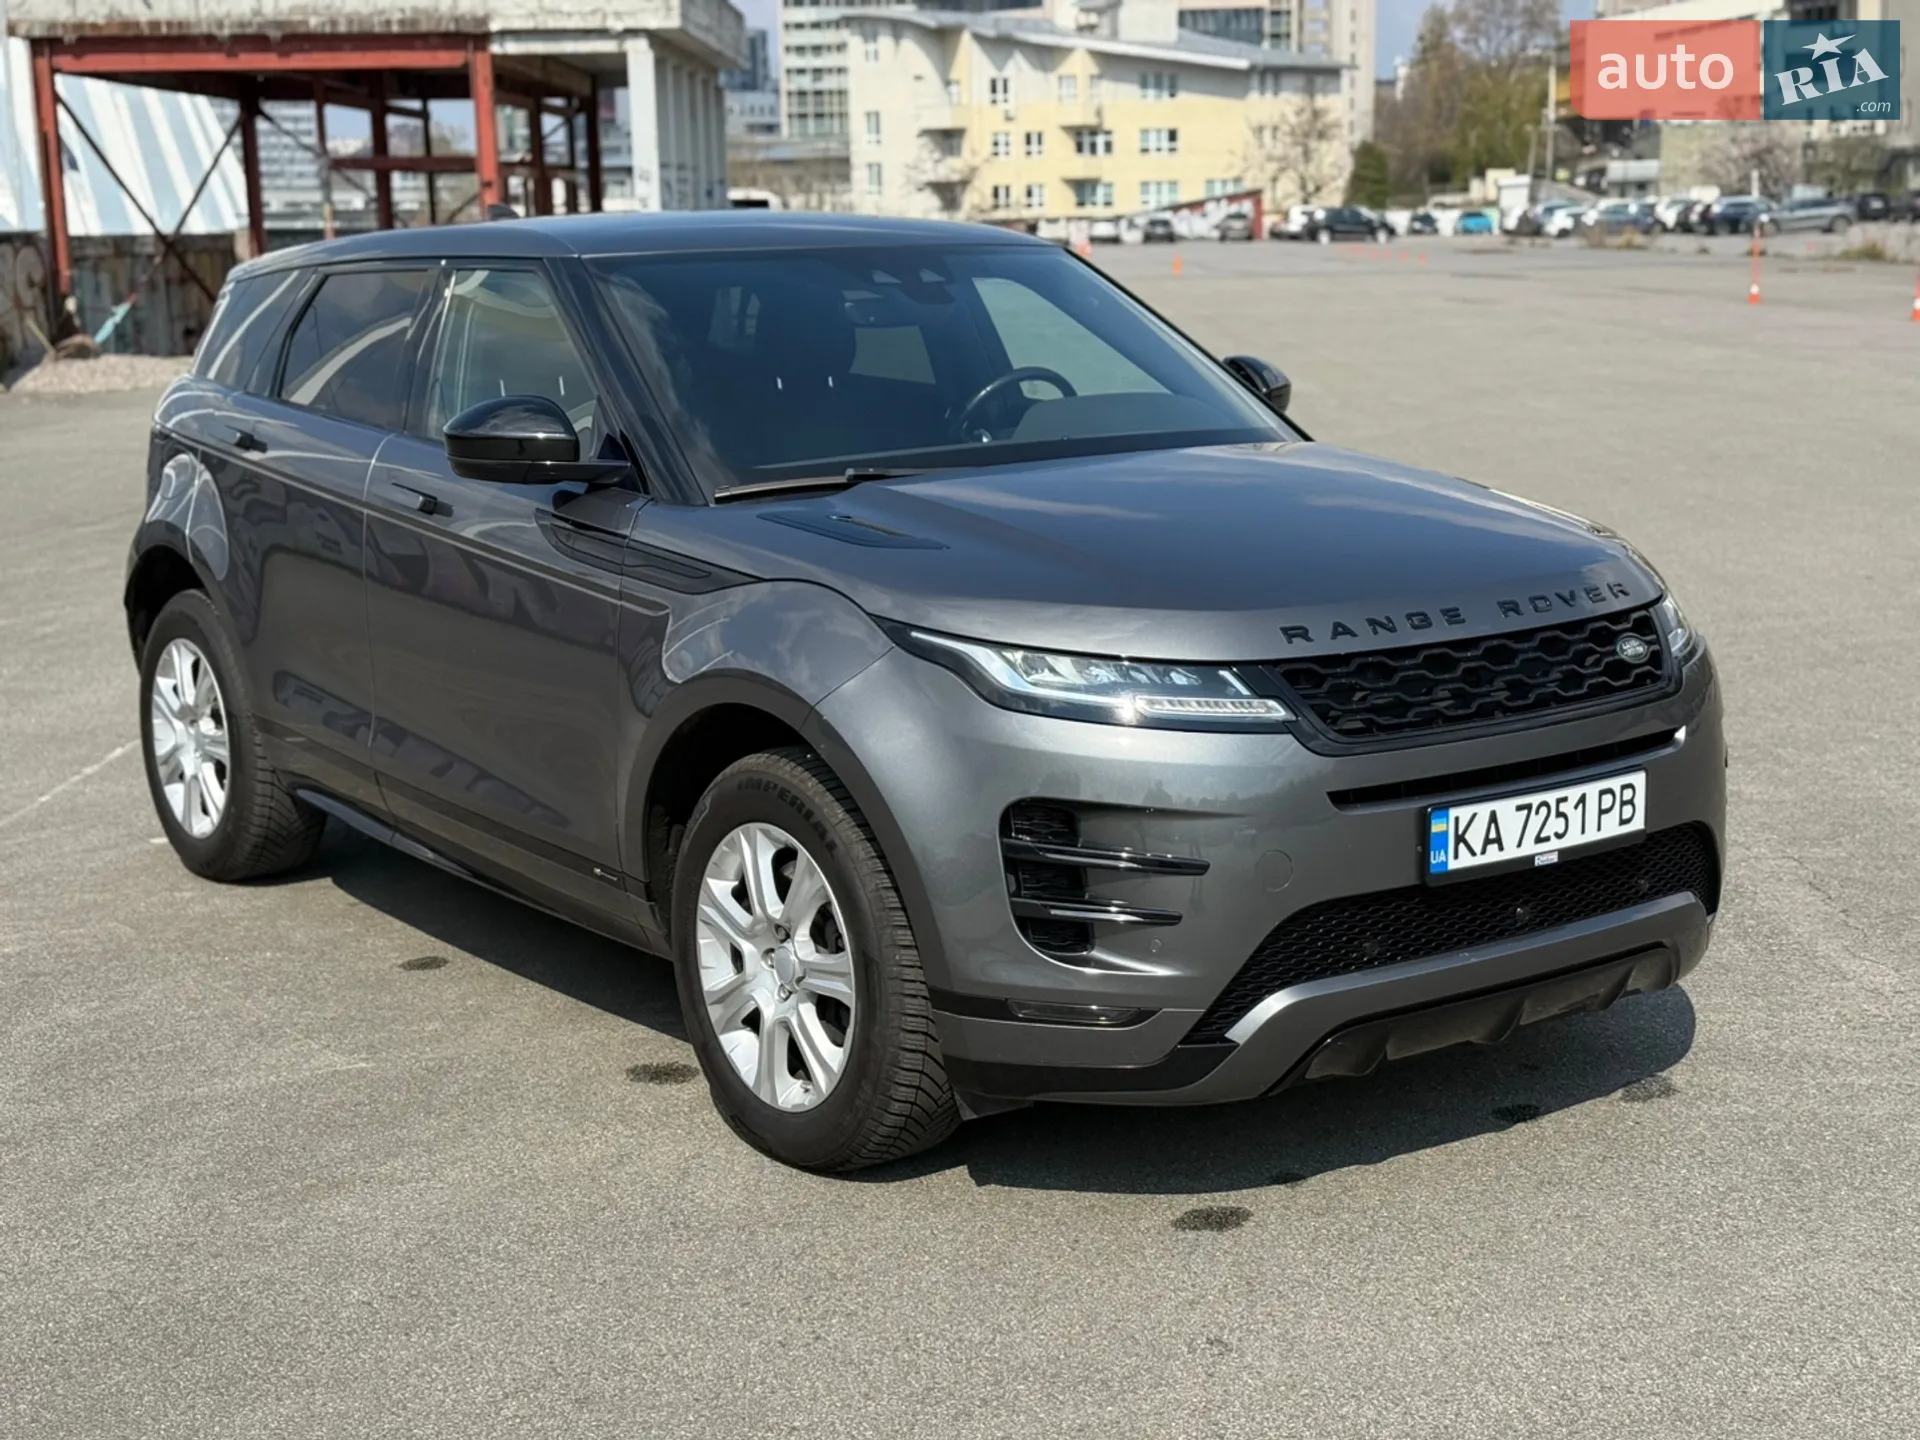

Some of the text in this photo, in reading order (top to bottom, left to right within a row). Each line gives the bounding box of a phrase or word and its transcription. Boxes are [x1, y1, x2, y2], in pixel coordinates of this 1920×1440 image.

[1279, 582, 1631, 645] RANGE ROVER
[1453, 782, 1637, 860] KA 7251 PB
[1430, 850, 1448, 865] UA
